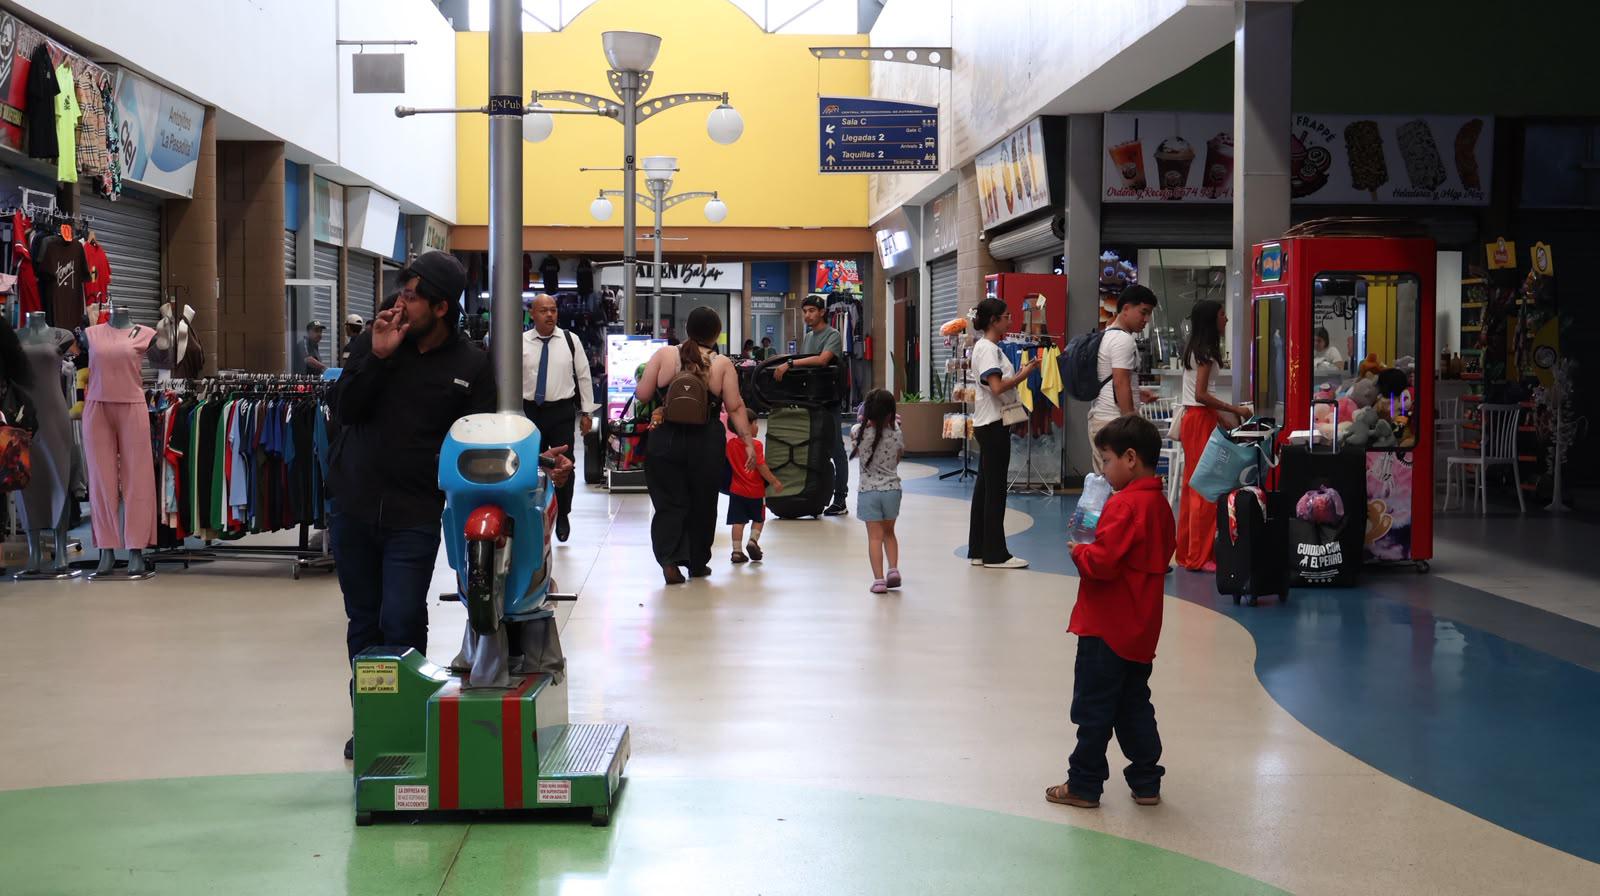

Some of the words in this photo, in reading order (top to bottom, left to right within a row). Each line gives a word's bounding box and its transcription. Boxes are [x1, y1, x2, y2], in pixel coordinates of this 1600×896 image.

[841, 118, 858, 126] Sala
[860, 118, 867, 126] C
[841, 134, 876, 143] Llegadas
[878, 133, 885, 141] 2
[842, 151, 875, 159] Taquillas
[878, 150, 884, 158] 2
[1310, 556, 1319, 568] EL
[1319, 552, 1343, 567] PERRO
